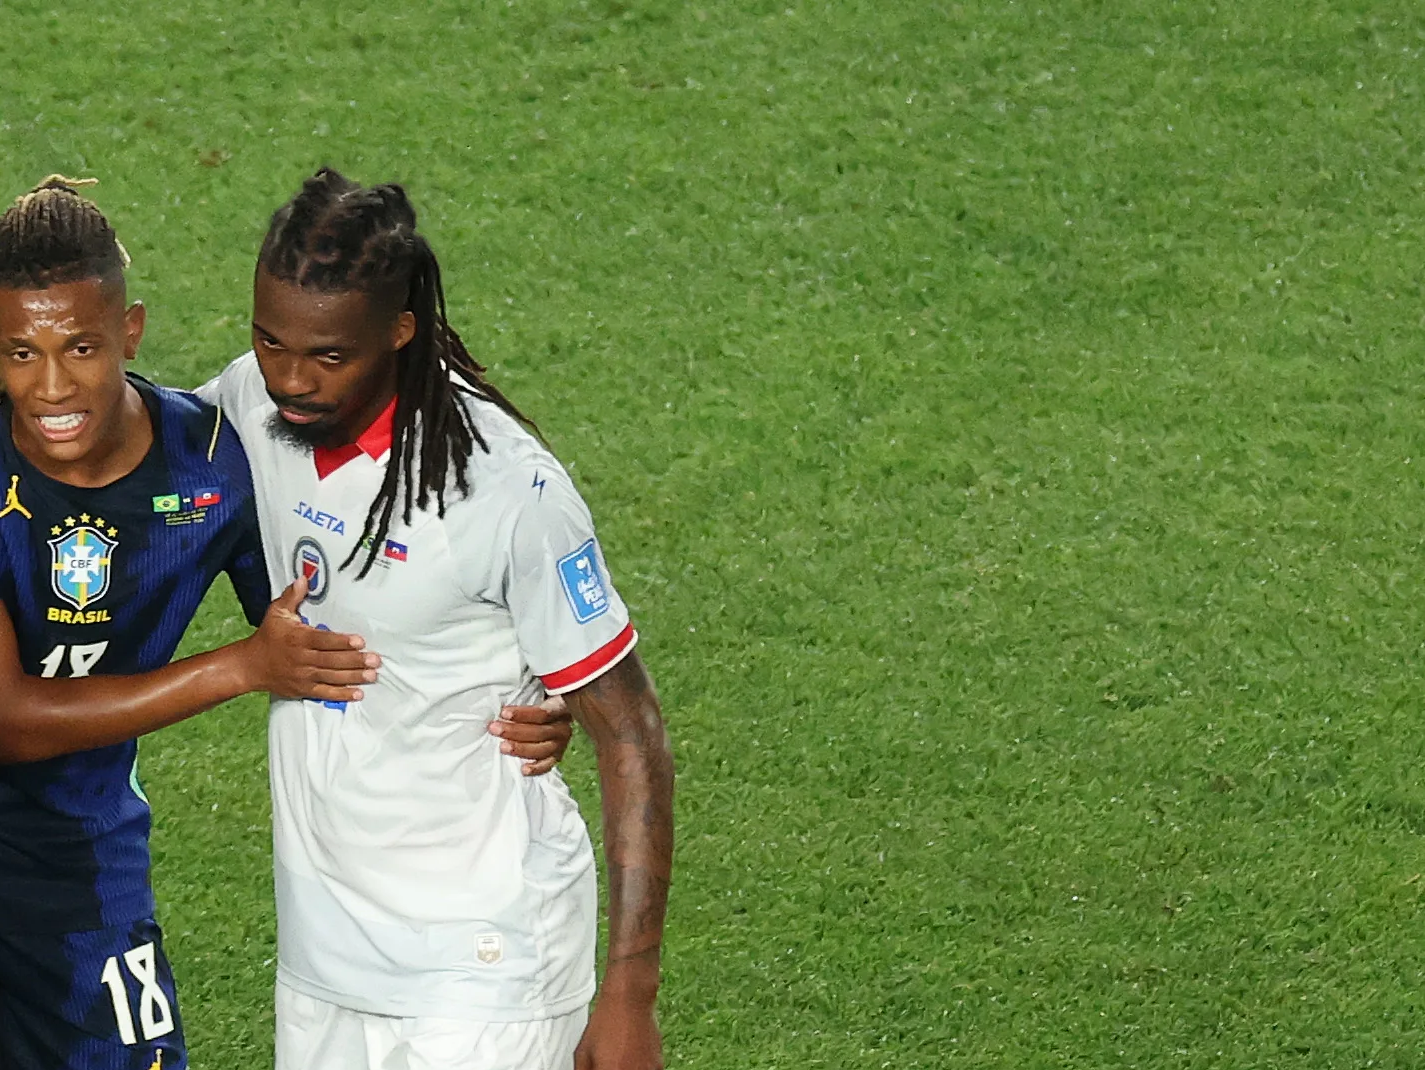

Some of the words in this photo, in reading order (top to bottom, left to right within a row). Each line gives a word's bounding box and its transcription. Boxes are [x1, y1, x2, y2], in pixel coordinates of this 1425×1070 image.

[70, 559, 93, 569] CBF
[47, 607, 112, 624] BRASIL
[100, 941, 175, 1045] 18
